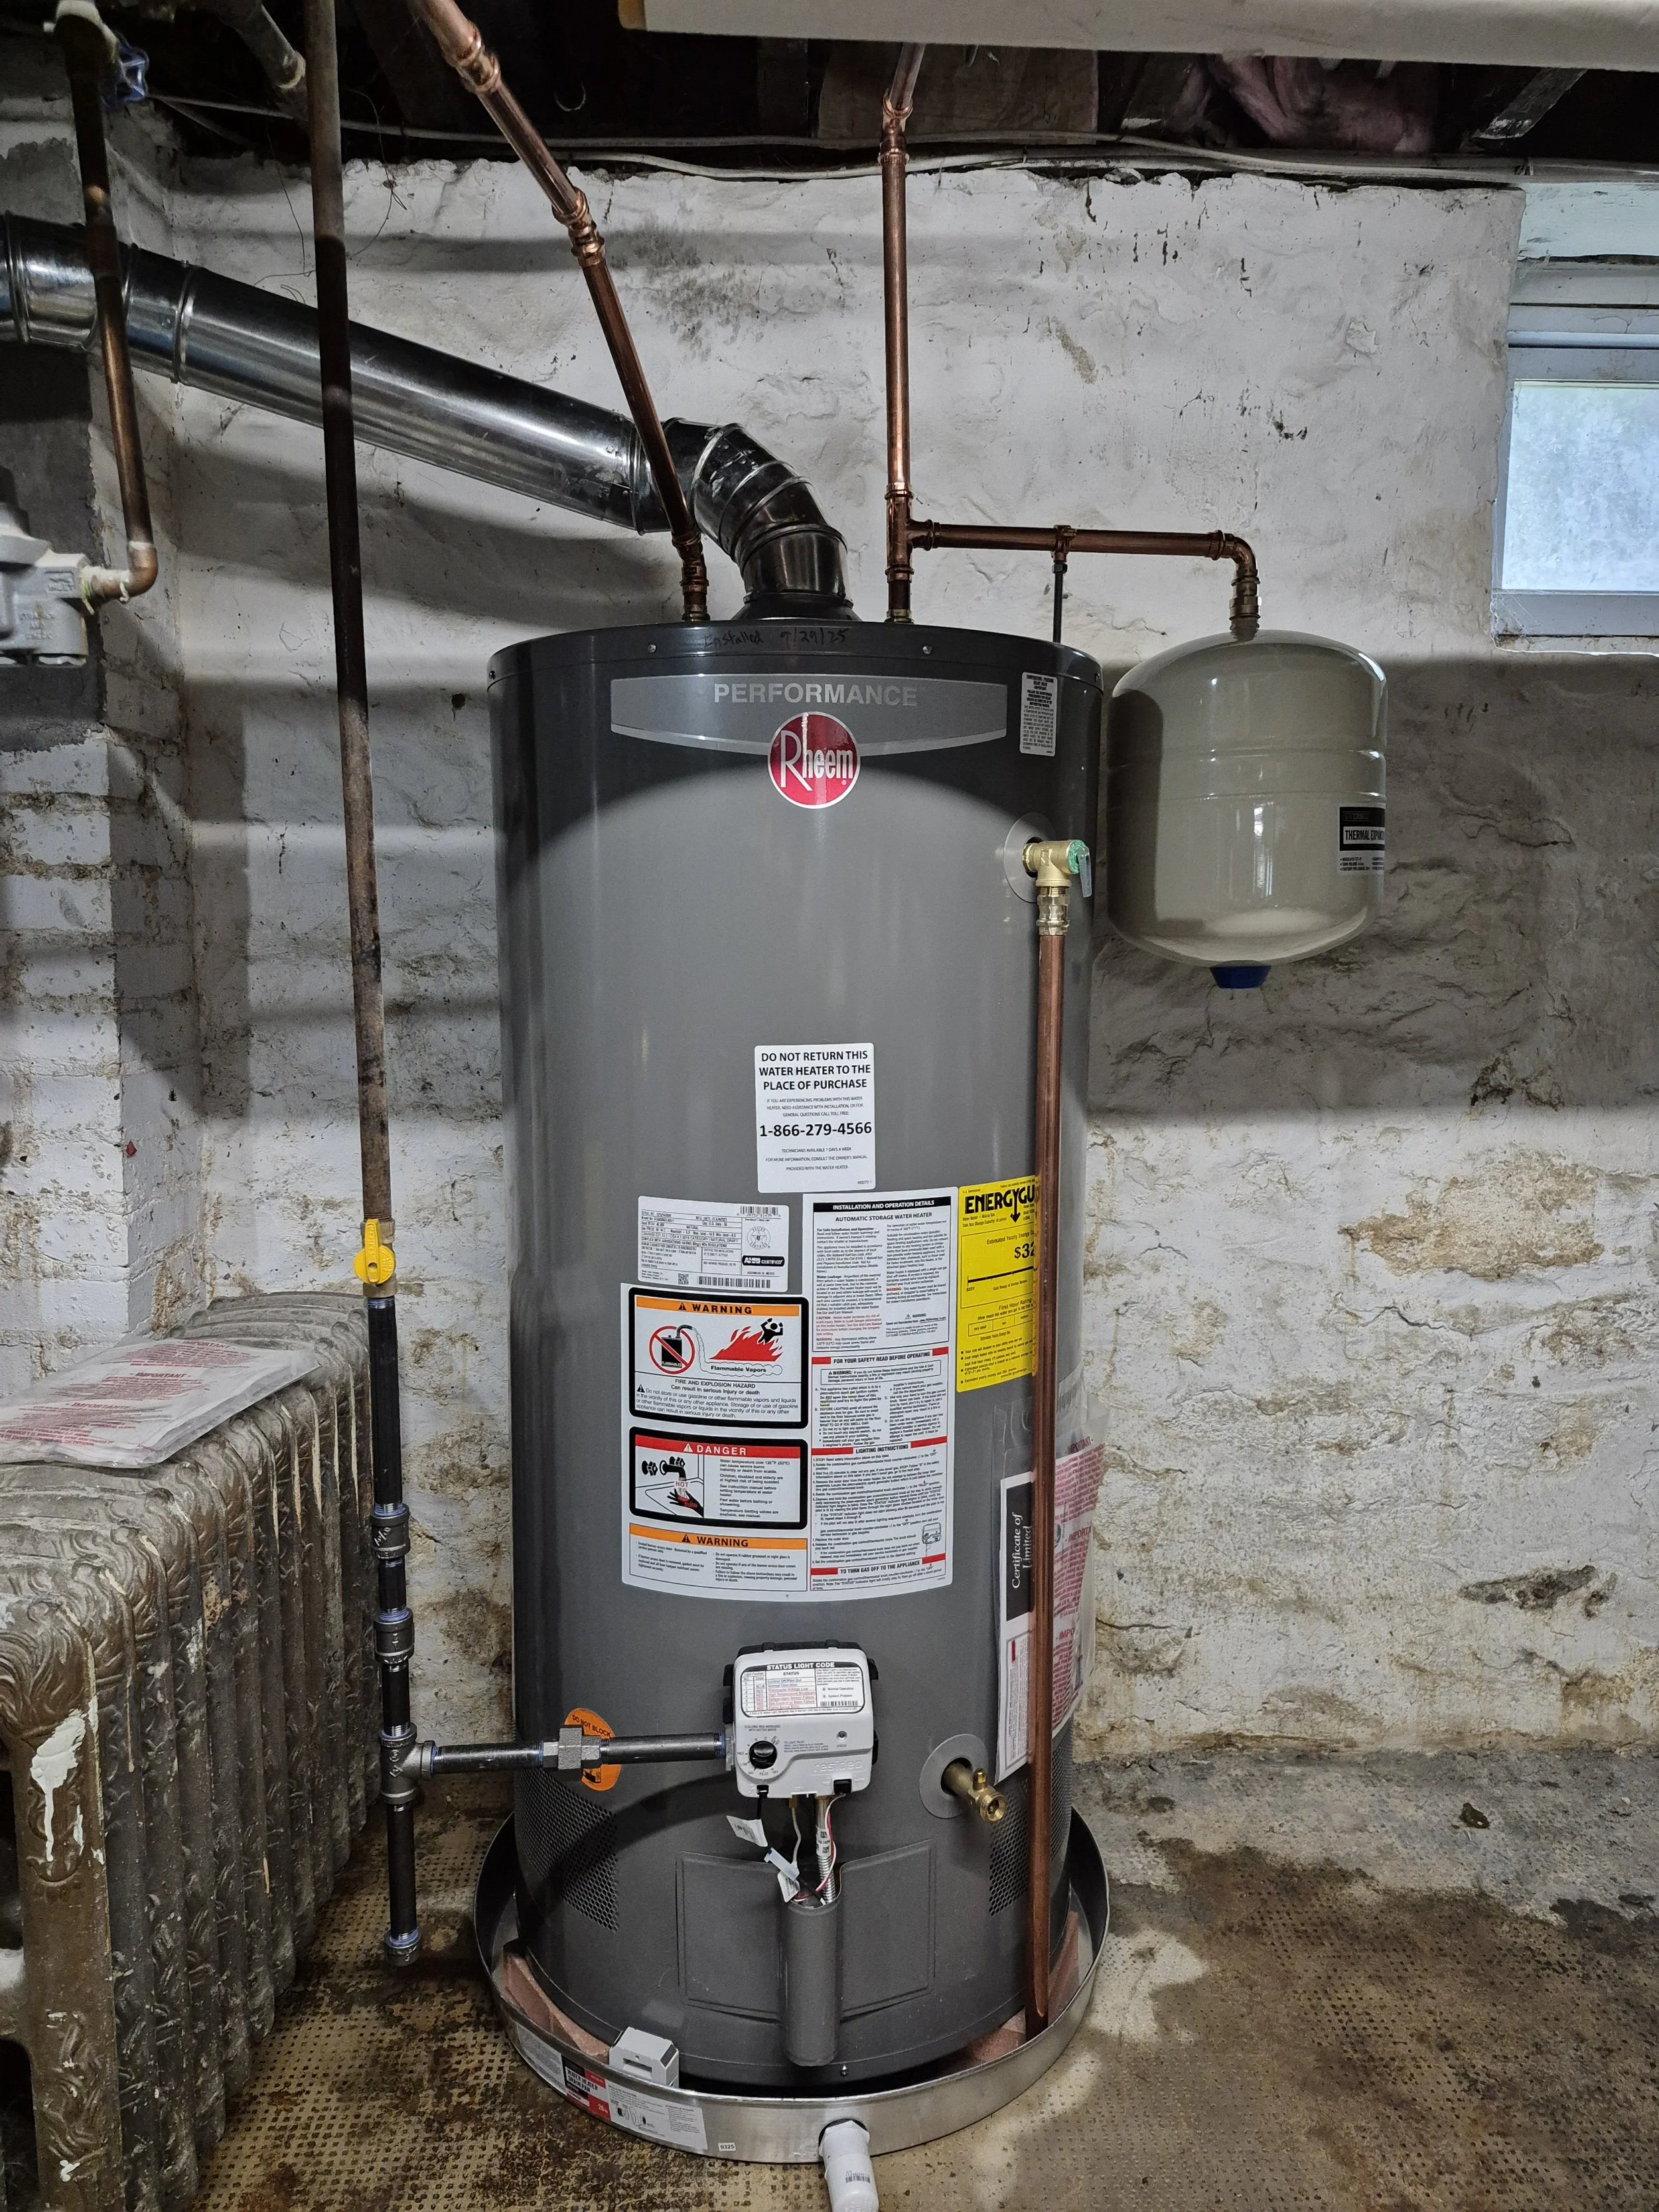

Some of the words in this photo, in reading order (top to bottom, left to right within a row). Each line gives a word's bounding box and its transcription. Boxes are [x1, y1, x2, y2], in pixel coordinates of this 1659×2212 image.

[714, 683, 917, 706] PERFORMANCE
[780, 711, 853, 791] Rheem
[1345, 830, 1370, 840] THERMAL
[761, 1053, 777, 1062] DO
[780, 1053, 801, 1061] NOT
[803, 1051, 843, 1061] RETURN
[845, 1050, 868, 1060] THIS
[759, 1067, 793, 1076] WATER
[796, 1066, 834, 1075] HEATER
[836, 1065, 849, 1074] TO
[851, 1065, 871, 1074] THE
[763, 1081, 795, 1090] PLACE
[798, 1080, 811, 1090] OF
[814, 1078, 867, 1089] PURCHASE
[760, 1122, 872, 1137] 1-866-279-4566
[965, 1184, 1035, 1215] ENERGYGU
[692, 1303, 752, 1314] WARNING
[182, 1340, 230, 1349] IMPORTANT
[697, 1445, 747, 1455] DANGER
[1012, 1512, 1023, 1526] of
[1068, 1526, 1091, 1542] IMPORTA
[697, 1536, 749, 1547] WARNING
[1023, 1525, 1032, 1569] Limited
[1012, 1528, 1023, 1589] Certificate
[1059, 1627, 1075, 1640] IMPO
[580, 1719, 591, 1729] NOT
[592, 1725, 612, 1737] BLOCK
[567, 2068, 581, 2081] WATER
[582, 2083, 591, 2092] PAN
